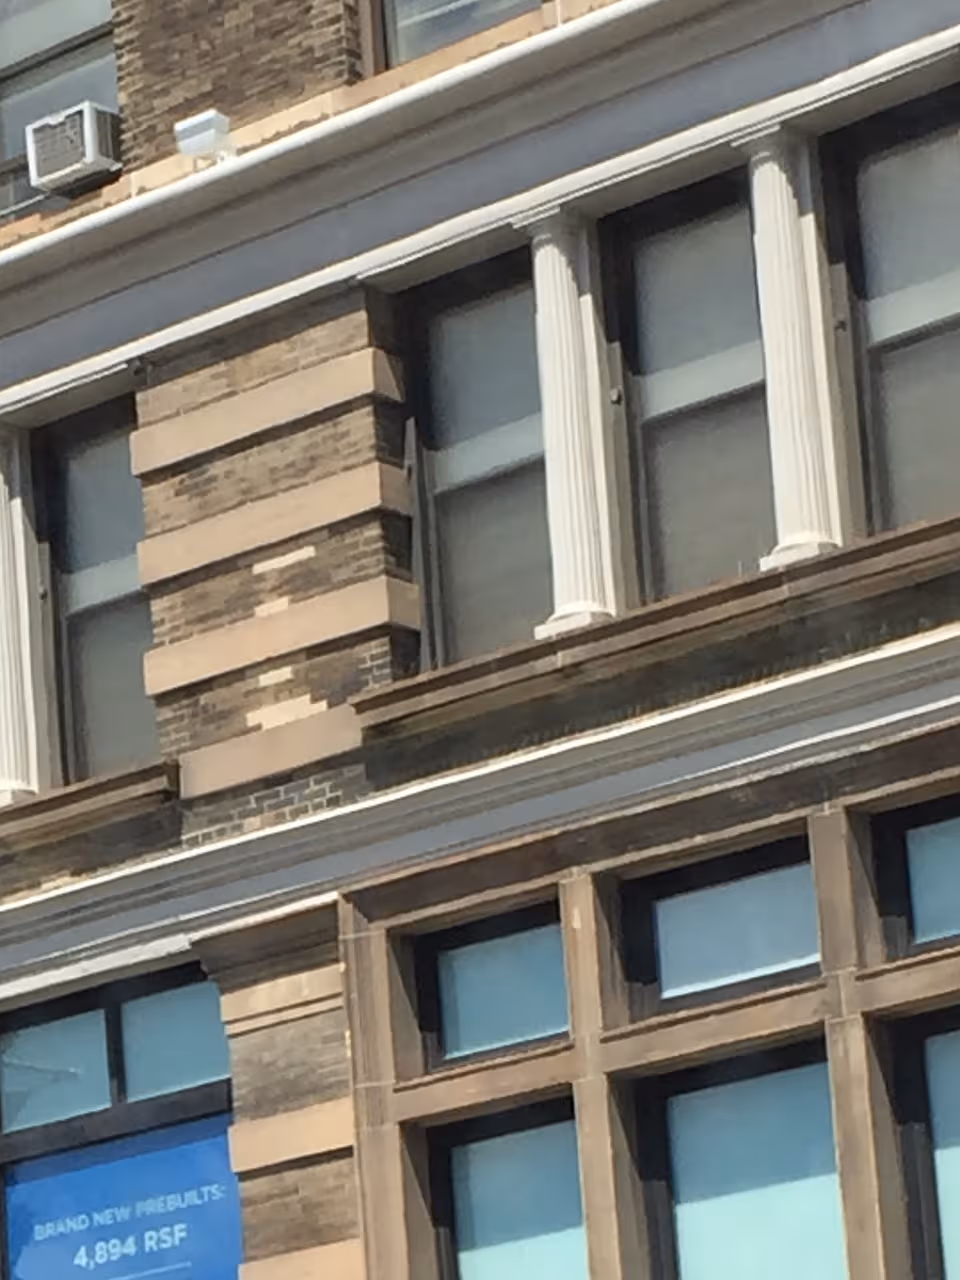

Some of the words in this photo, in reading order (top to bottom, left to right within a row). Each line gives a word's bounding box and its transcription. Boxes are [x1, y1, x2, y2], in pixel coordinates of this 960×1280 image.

[33, 1214, 90, 1241] BRAND
[93, 1206, 130, 1227] NEW
[73, 1235, 137, 1270] 4,894
[144, 1223, 188, 1254] RSF
